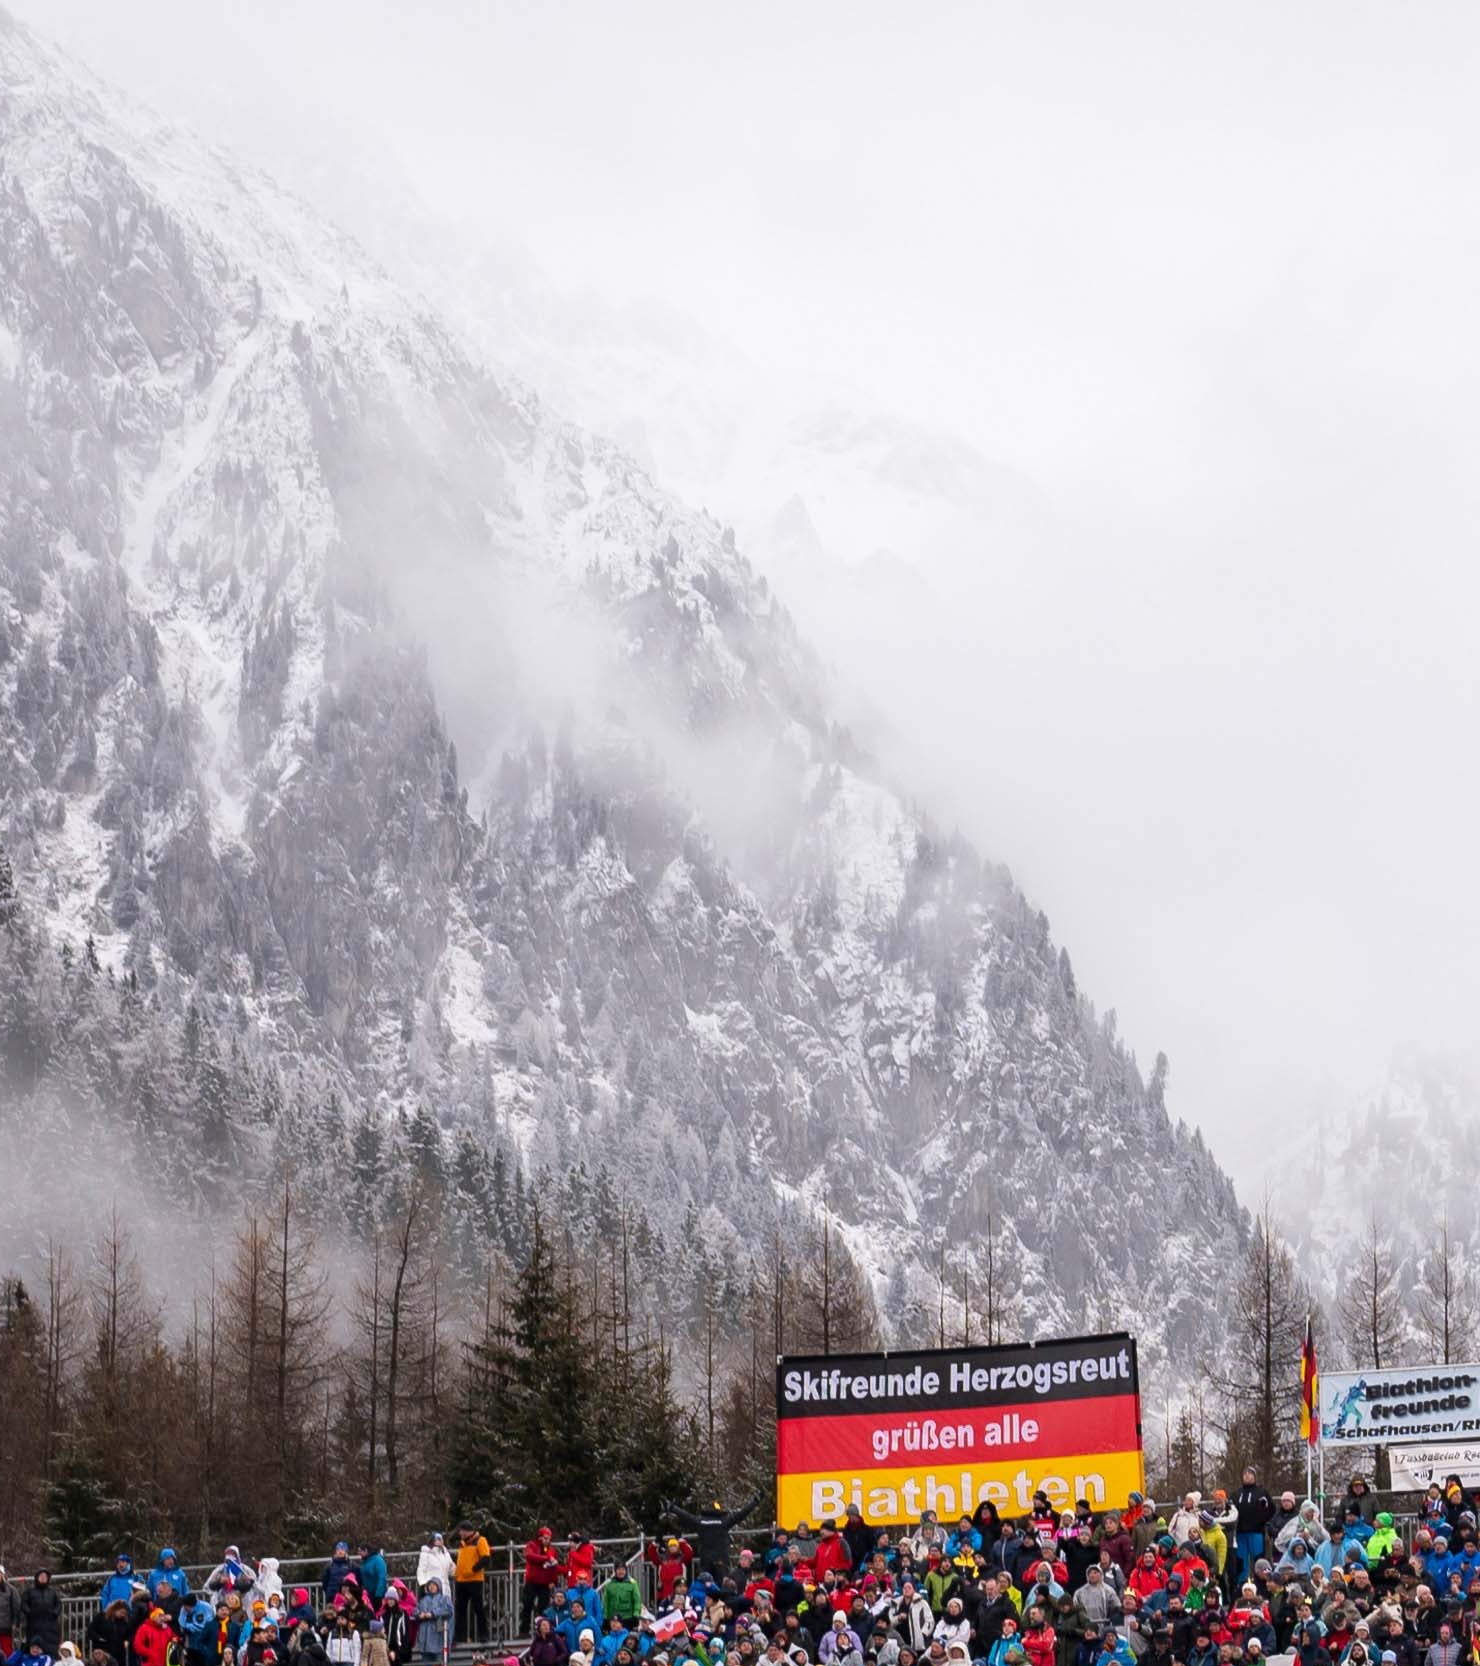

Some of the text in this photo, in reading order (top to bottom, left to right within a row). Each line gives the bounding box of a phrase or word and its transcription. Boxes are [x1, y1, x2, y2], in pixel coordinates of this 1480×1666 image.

[784, 1349, 1130, 1402] Skifreunde Herzogsreut
[1365, 1374, 1478, 1402] Biathlon-
[1370, 1394, 1471, 1420] freunde
[872, 1414, 1040, 1461] grüßen alle
[810, 1467, 1107, 1521] Biathleten
